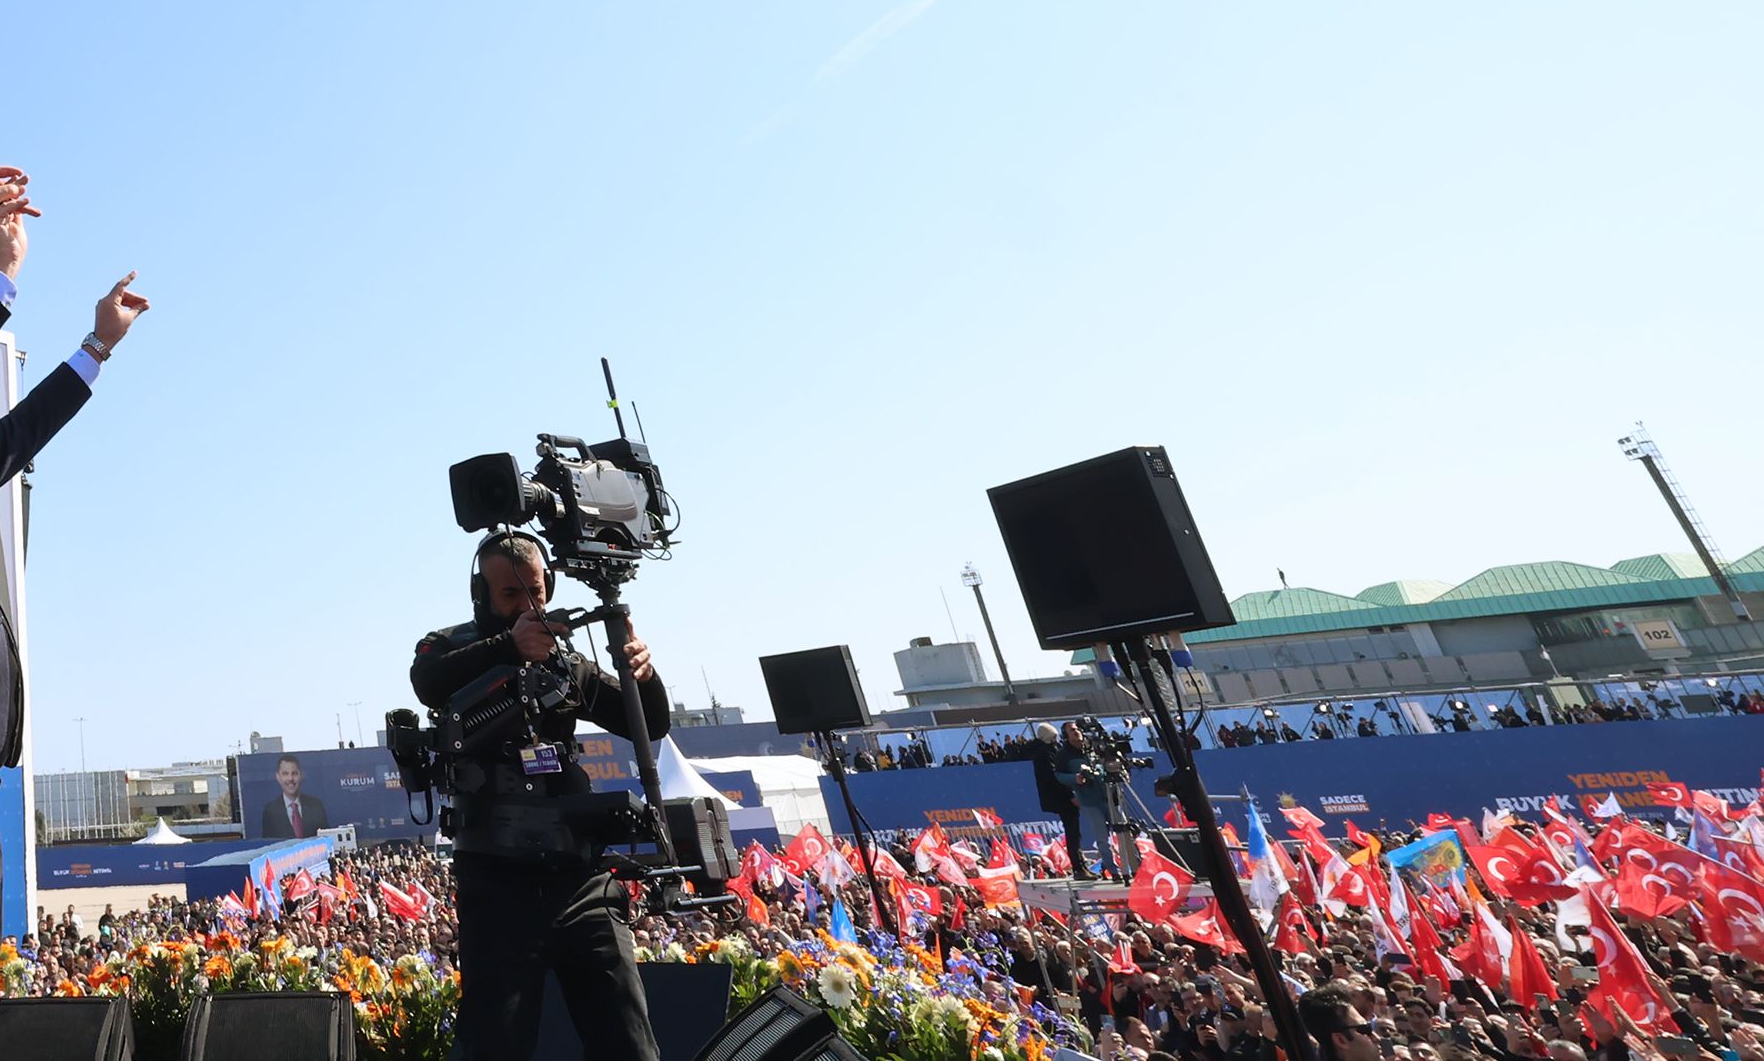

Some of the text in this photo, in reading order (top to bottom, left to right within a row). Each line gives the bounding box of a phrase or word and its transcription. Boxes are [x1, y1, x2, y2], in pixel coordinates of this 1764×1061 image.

[1644, 630, 1672, 640] 102
[340, 777, 375, 787] KURUM
[1319, 795, 1366, 805] SADECE
